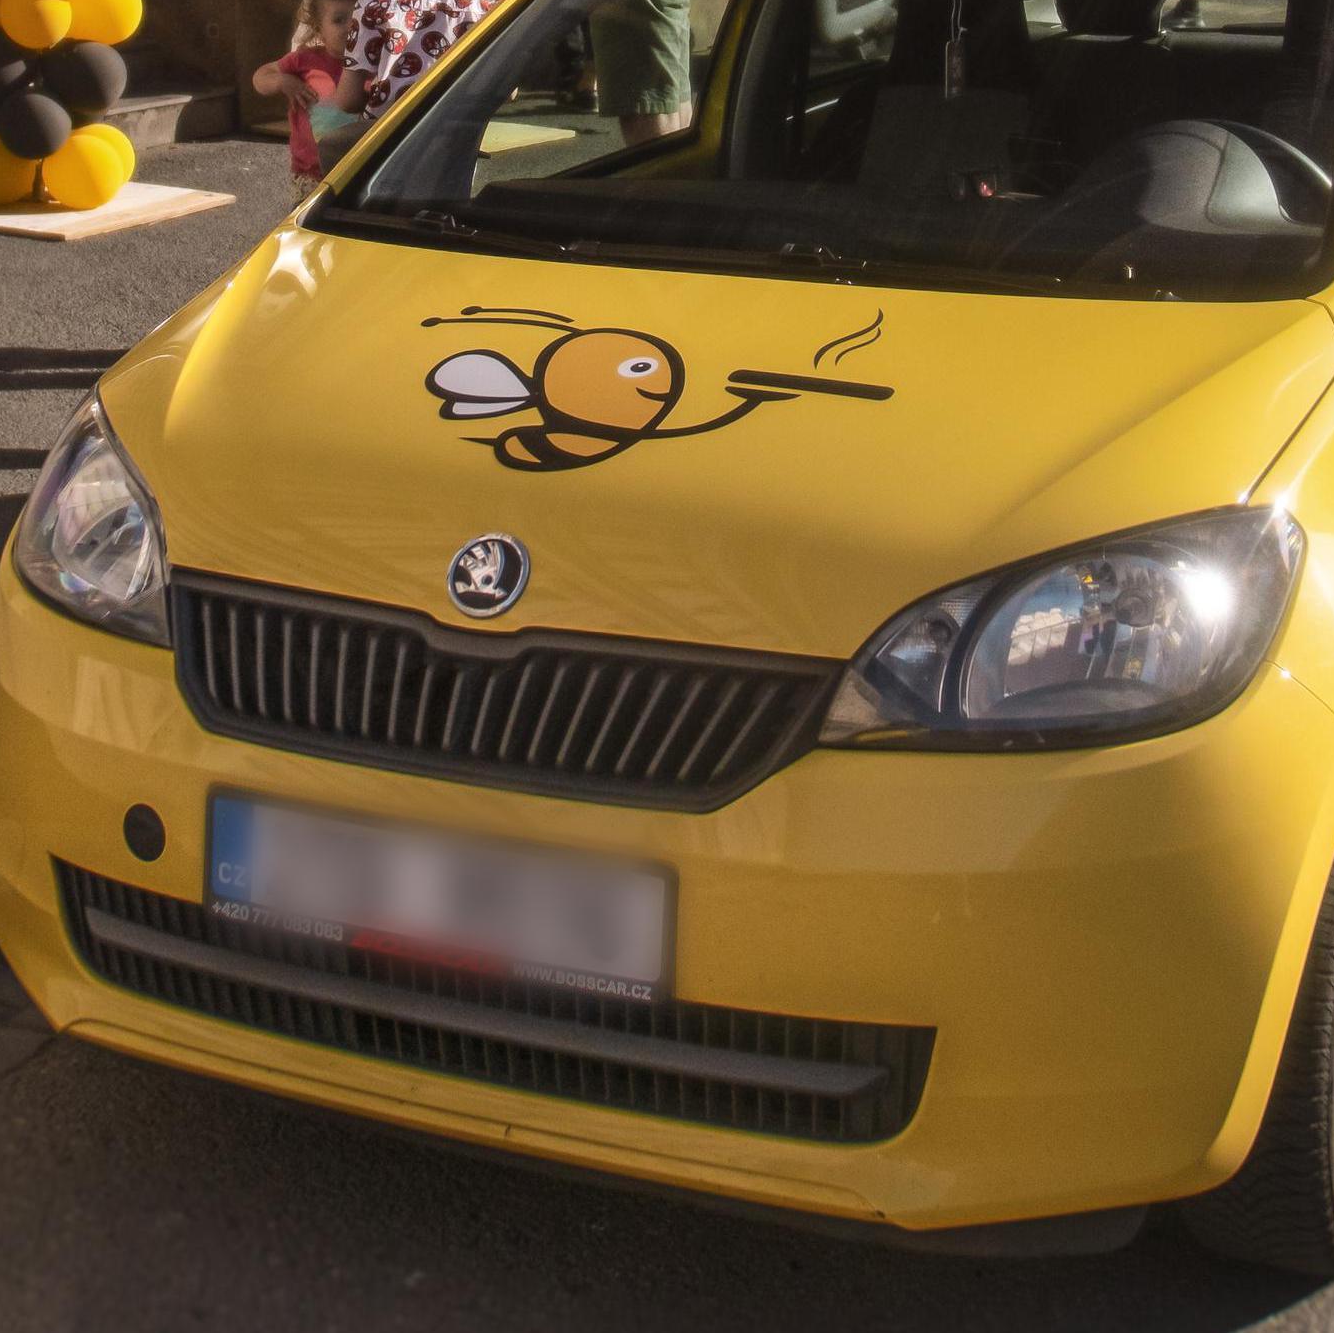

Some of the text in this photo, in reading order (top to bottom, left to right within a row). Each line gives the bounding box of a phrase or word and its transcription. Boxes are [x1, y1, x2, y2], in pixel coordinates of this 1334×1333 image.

[218, 862, 246, 887] CZ
[212, 900, 249, 921] +420
[513, 962, 653, 1001] WWW.BOSSCAR.CZ
